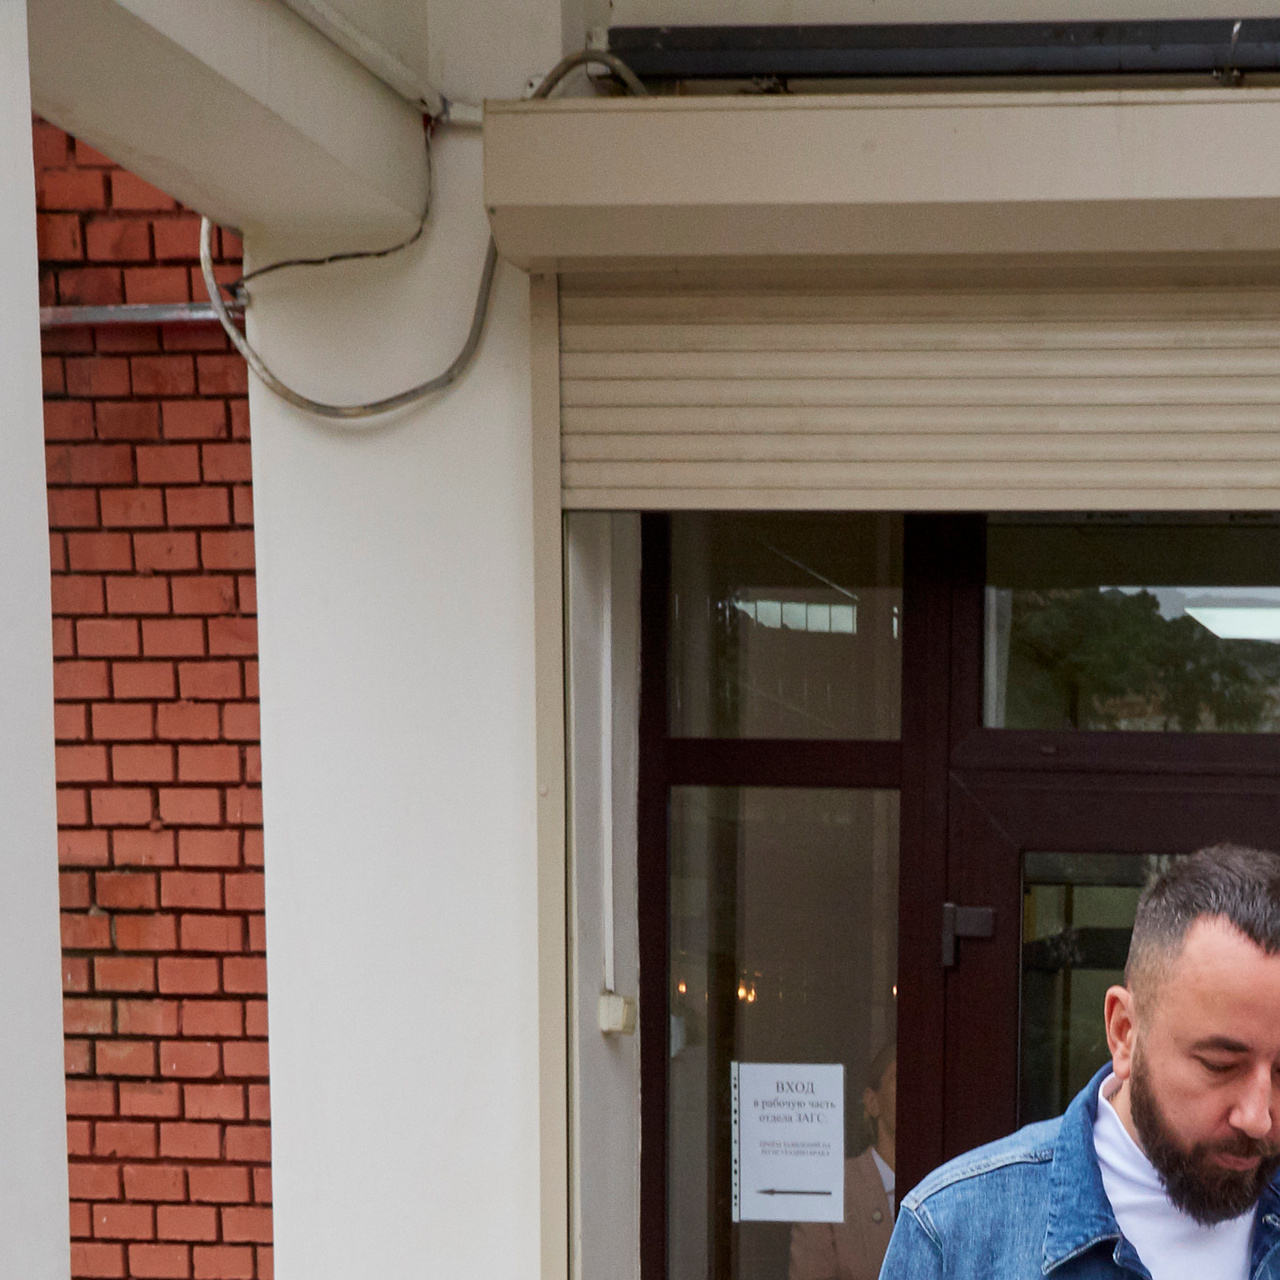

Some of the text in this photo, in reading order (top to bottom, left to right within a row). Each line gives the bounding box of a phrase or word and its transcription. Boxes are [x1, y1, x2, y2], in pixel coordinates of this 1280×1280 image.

[776, 1081, 815, 1095] ВХОД
[761, 1098, 806, 1110] рабочую
[808, 1100, 836, 1109] часть
[759, 1114, 793, 1123] отдела
